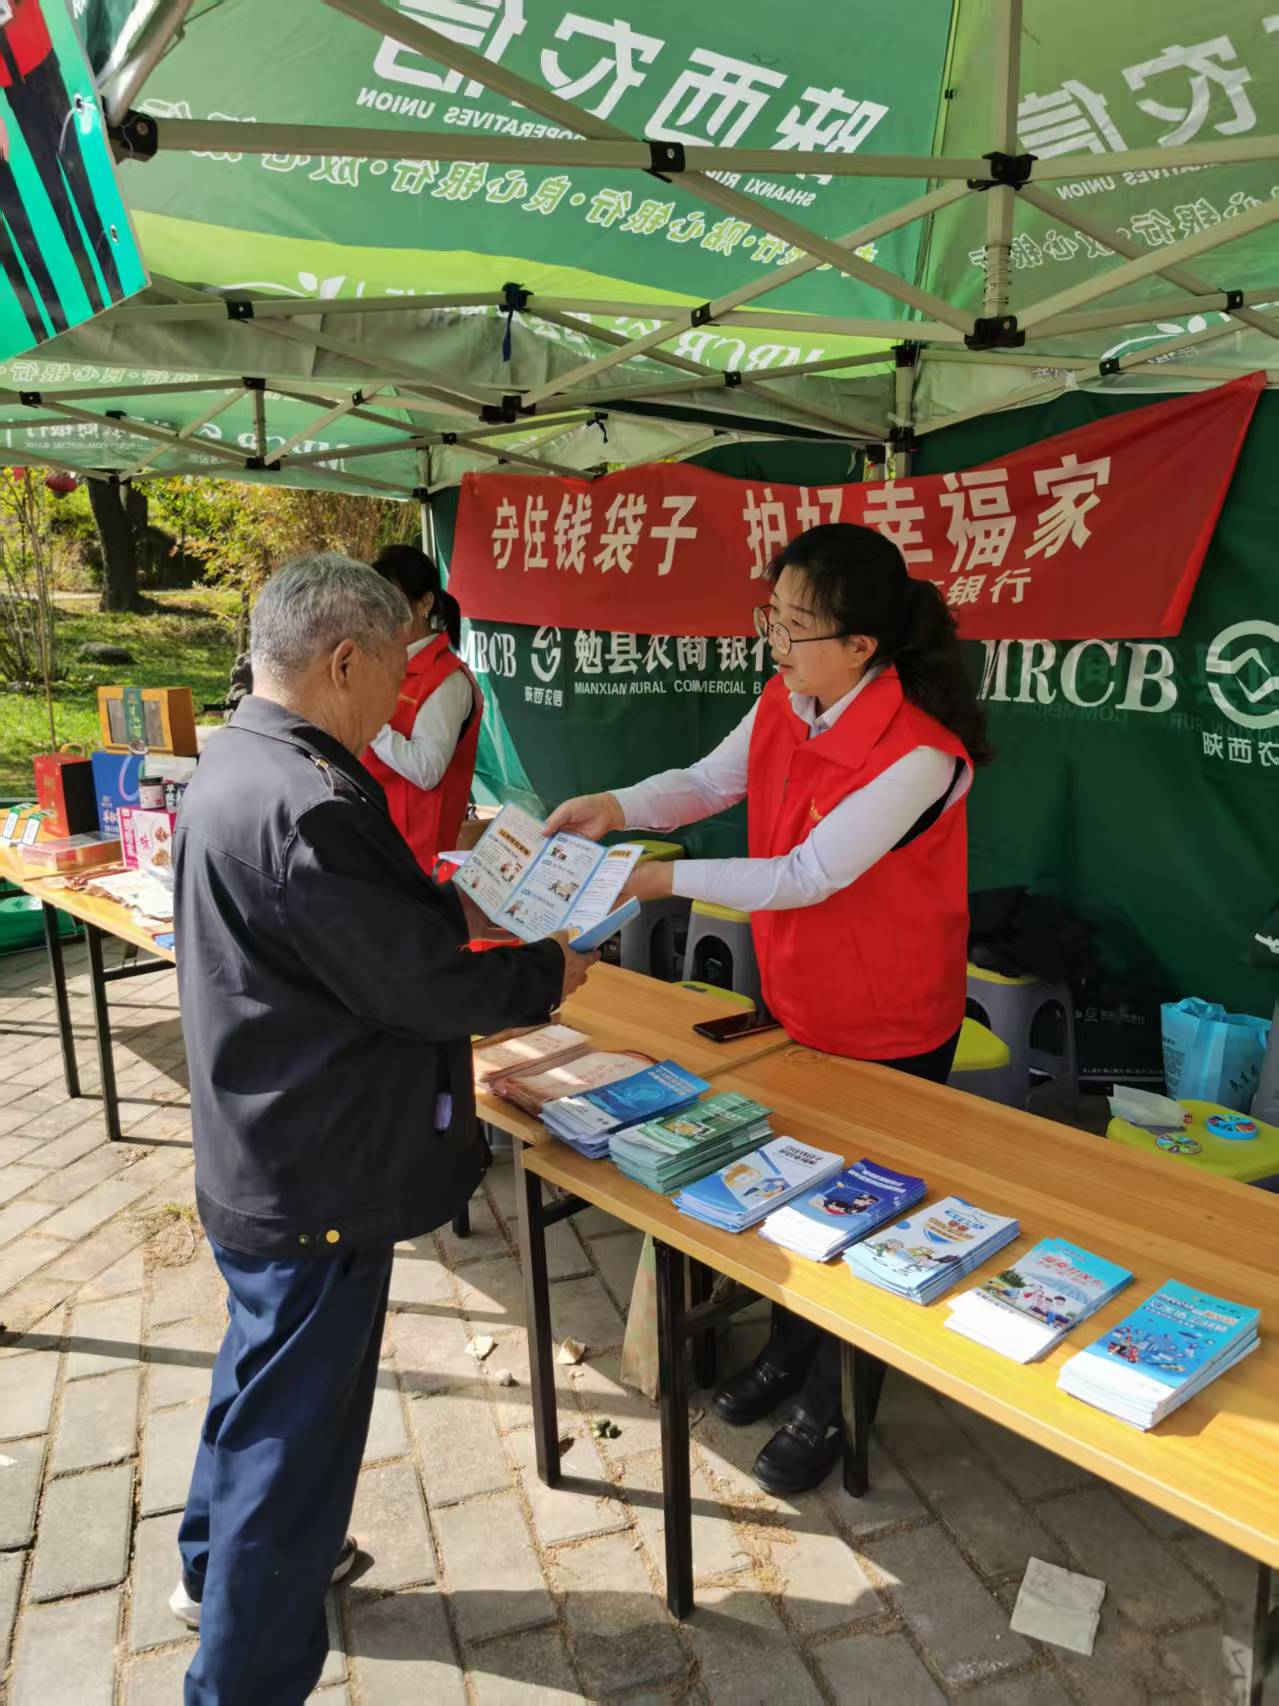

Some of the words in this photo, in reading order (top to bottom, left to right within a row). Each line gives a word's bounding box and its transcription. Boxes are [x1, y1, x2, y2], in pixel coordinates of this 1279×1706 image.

[491, 492, 698, 577] 守住钱袋子
[929, 568, 1032, 605] 银行
[629, 681, 668, 695] RURAL
